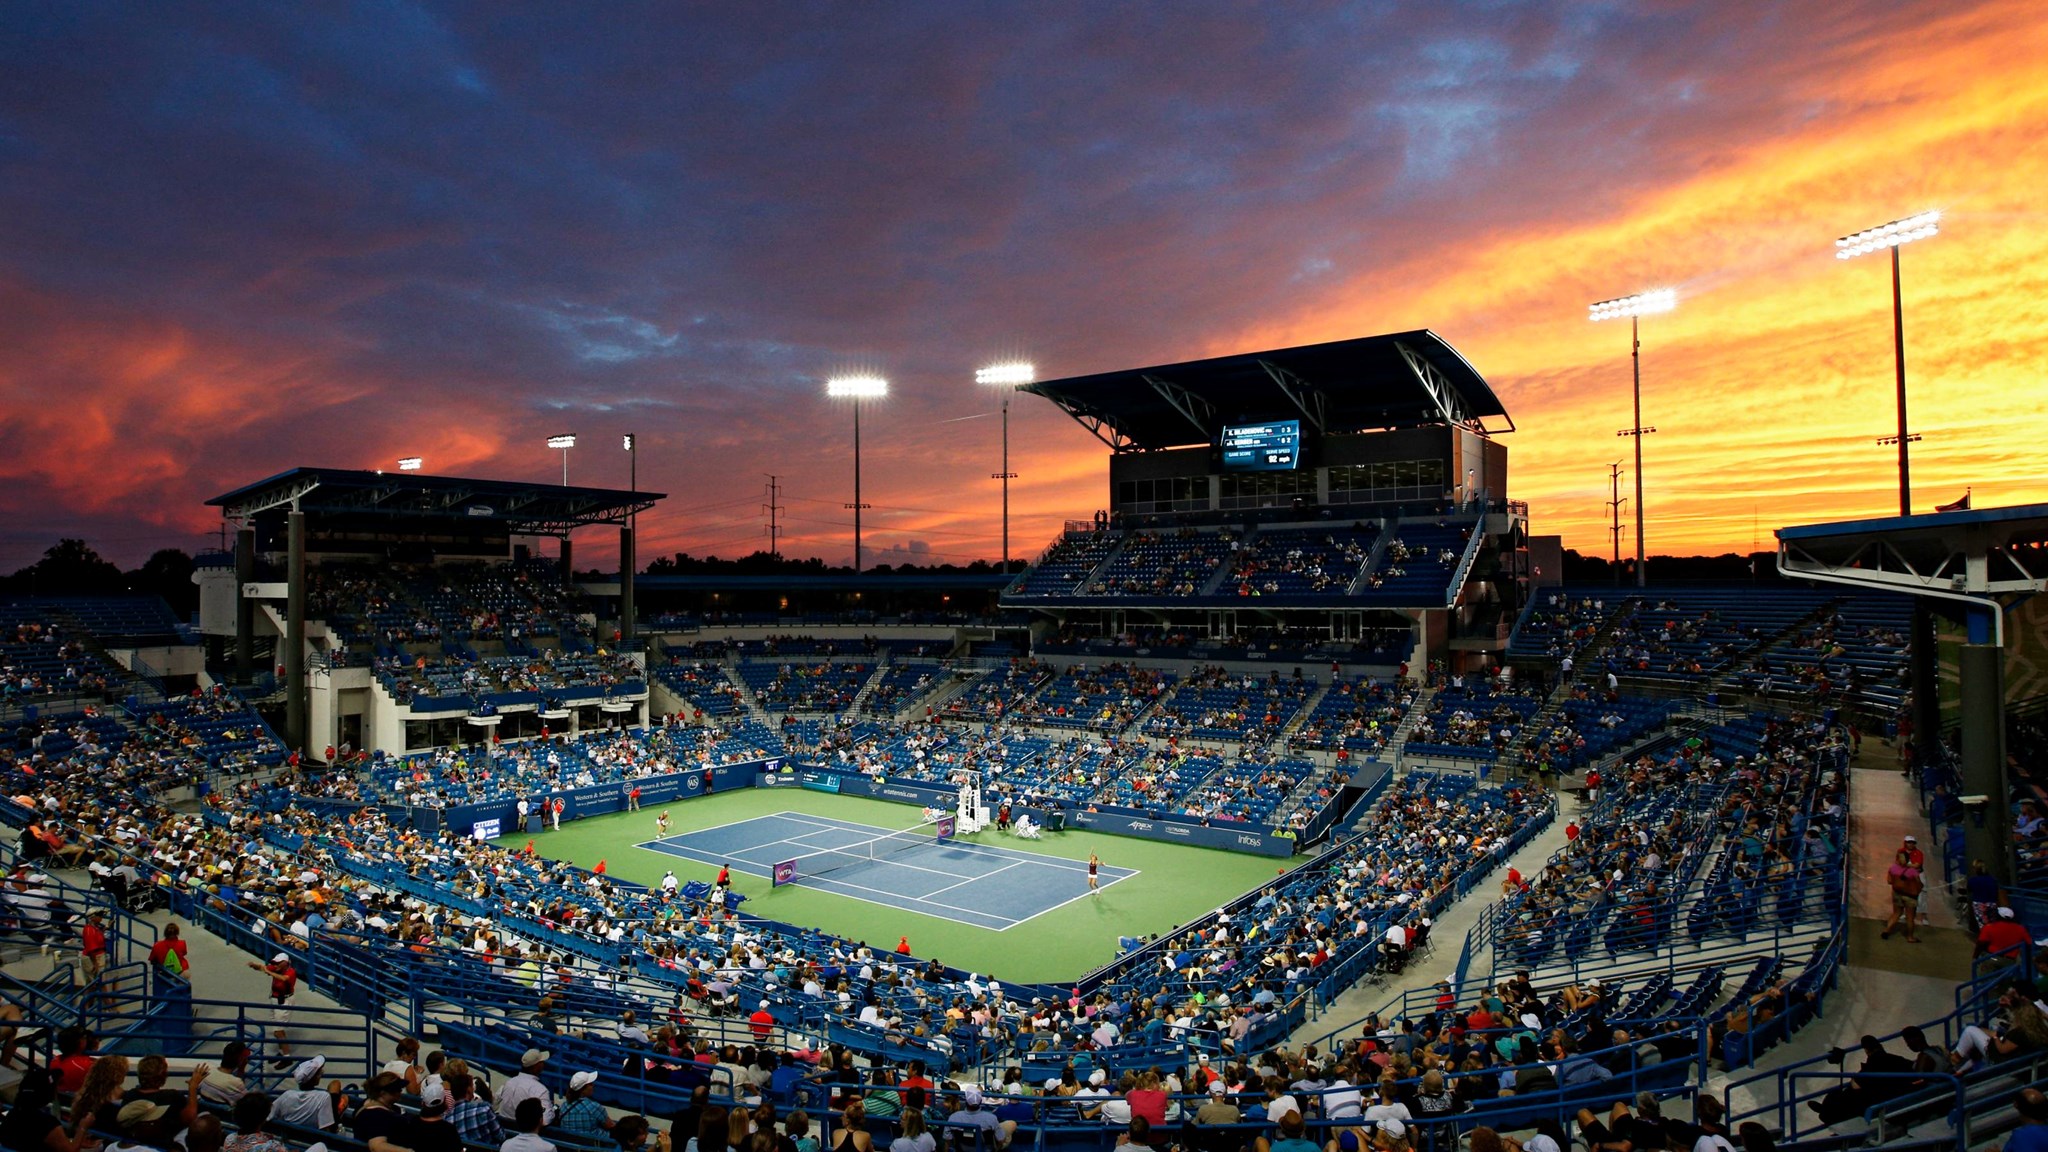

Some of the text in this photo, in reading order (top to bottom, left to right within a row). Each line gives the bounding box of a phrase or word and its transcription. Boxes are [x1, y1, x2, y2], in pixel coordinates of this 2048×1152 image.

[574, 793, 593, 802] Western
[599, 790, 618, 798] Southern
[883, 788, 918, 799] wtatennis.com
[474, 818, 500, 828] CITIZEN
[1238, 835, 1261, 847] Infosys
[780, 868, 792, 876] WTA
